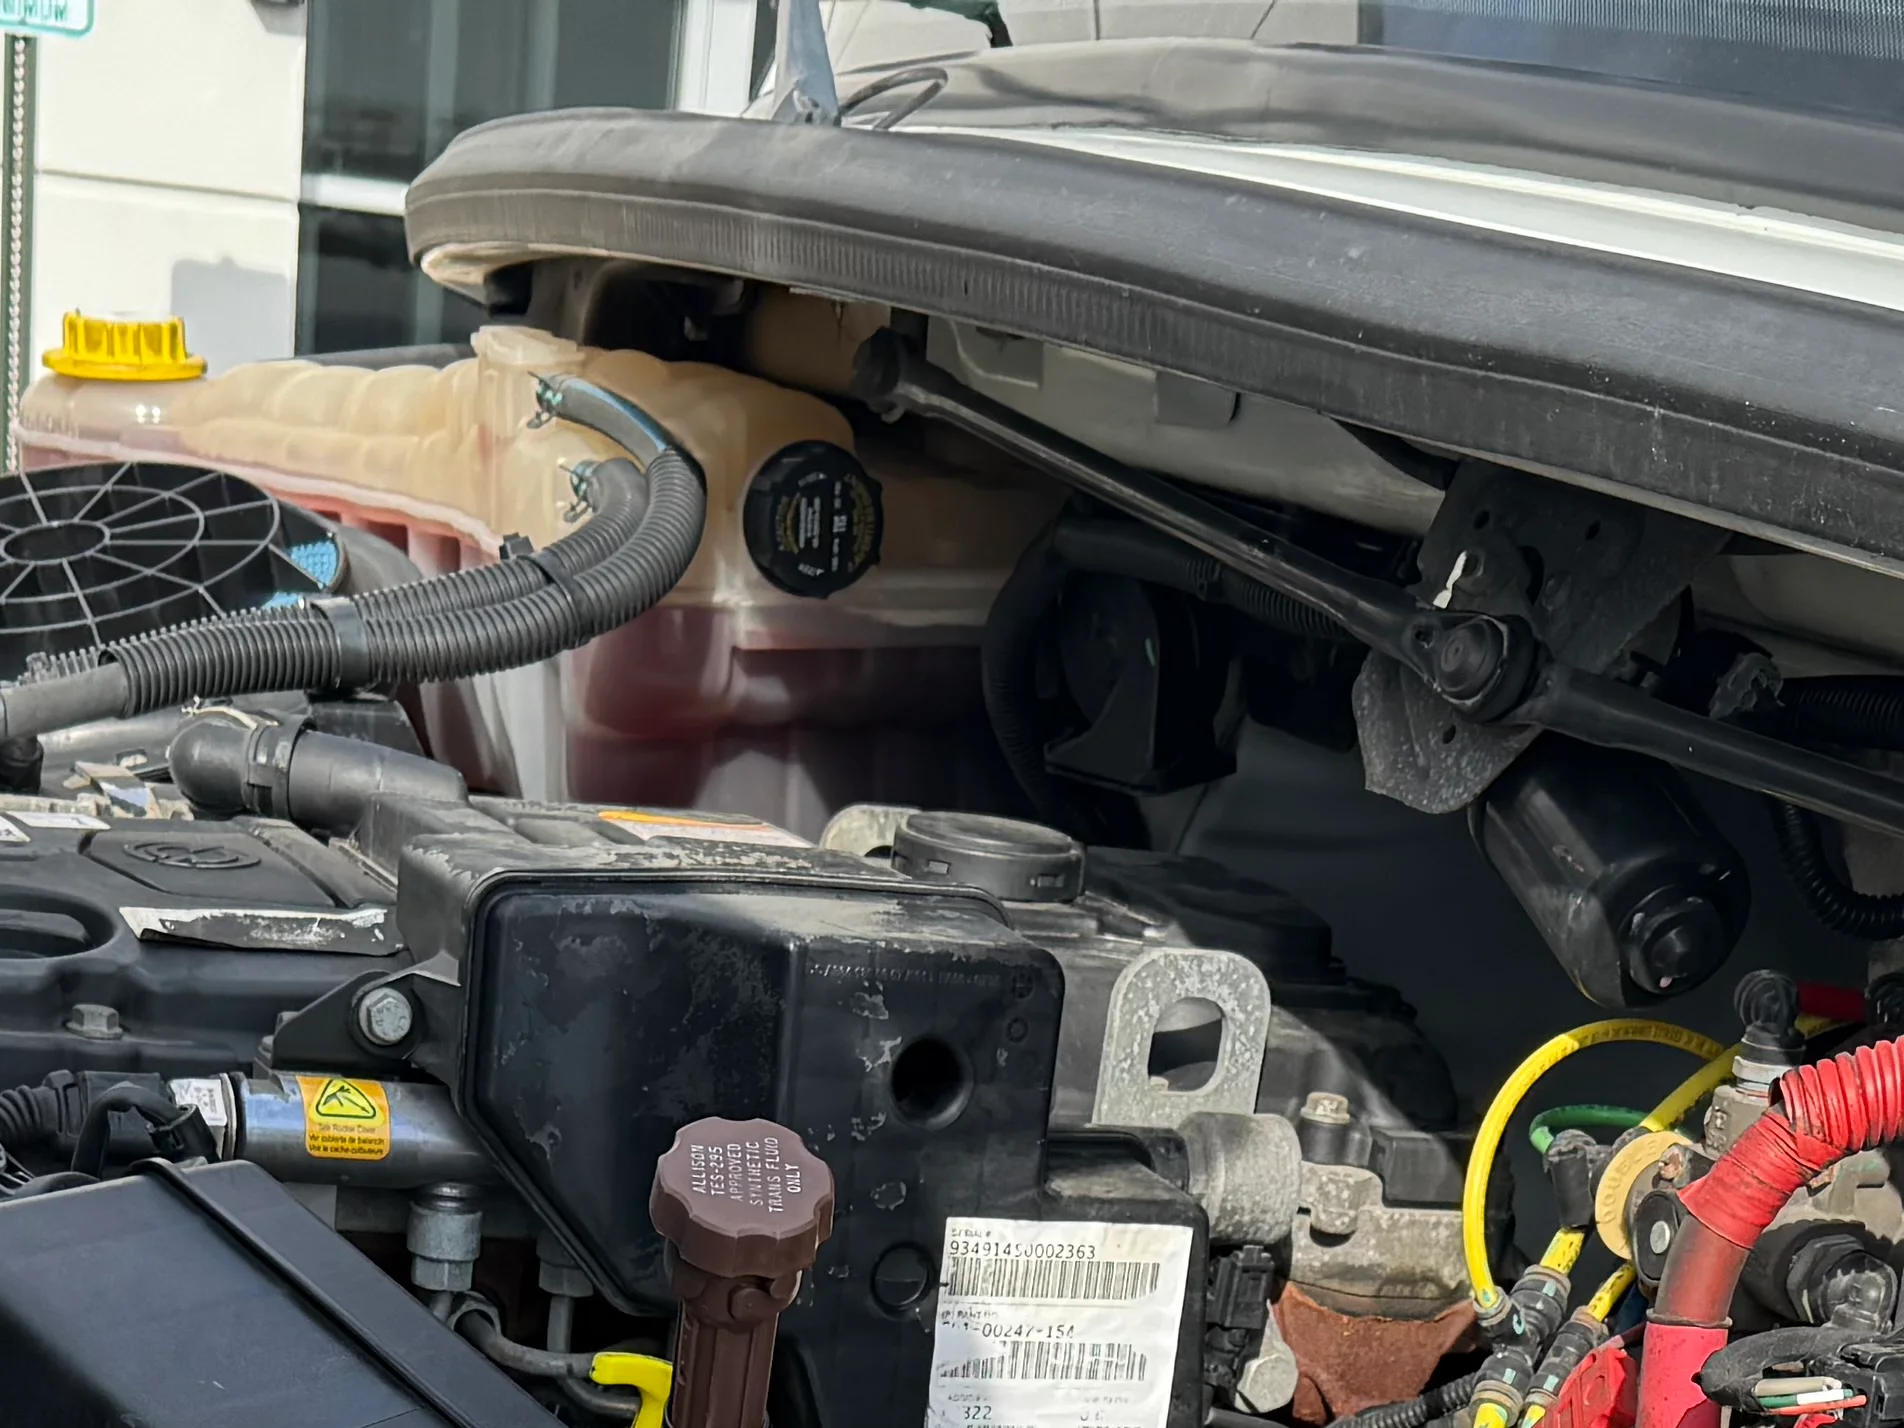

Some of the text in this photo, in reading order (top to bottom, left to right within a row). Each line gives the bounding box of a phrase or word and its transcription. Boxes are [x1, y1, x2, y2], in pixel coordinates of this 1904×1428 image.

[691, 1144, 707, 1194] ALLISON
[708, 1146, 725, 1196] TES-295
[727, 1143, 744, 1201] APPROVED
[746, 1141, 763, 1206] SYNTHETIC
[764, 1137, 784, 1213] TRANS FLUID
[785, 1163, 802, 1194] ONLY
